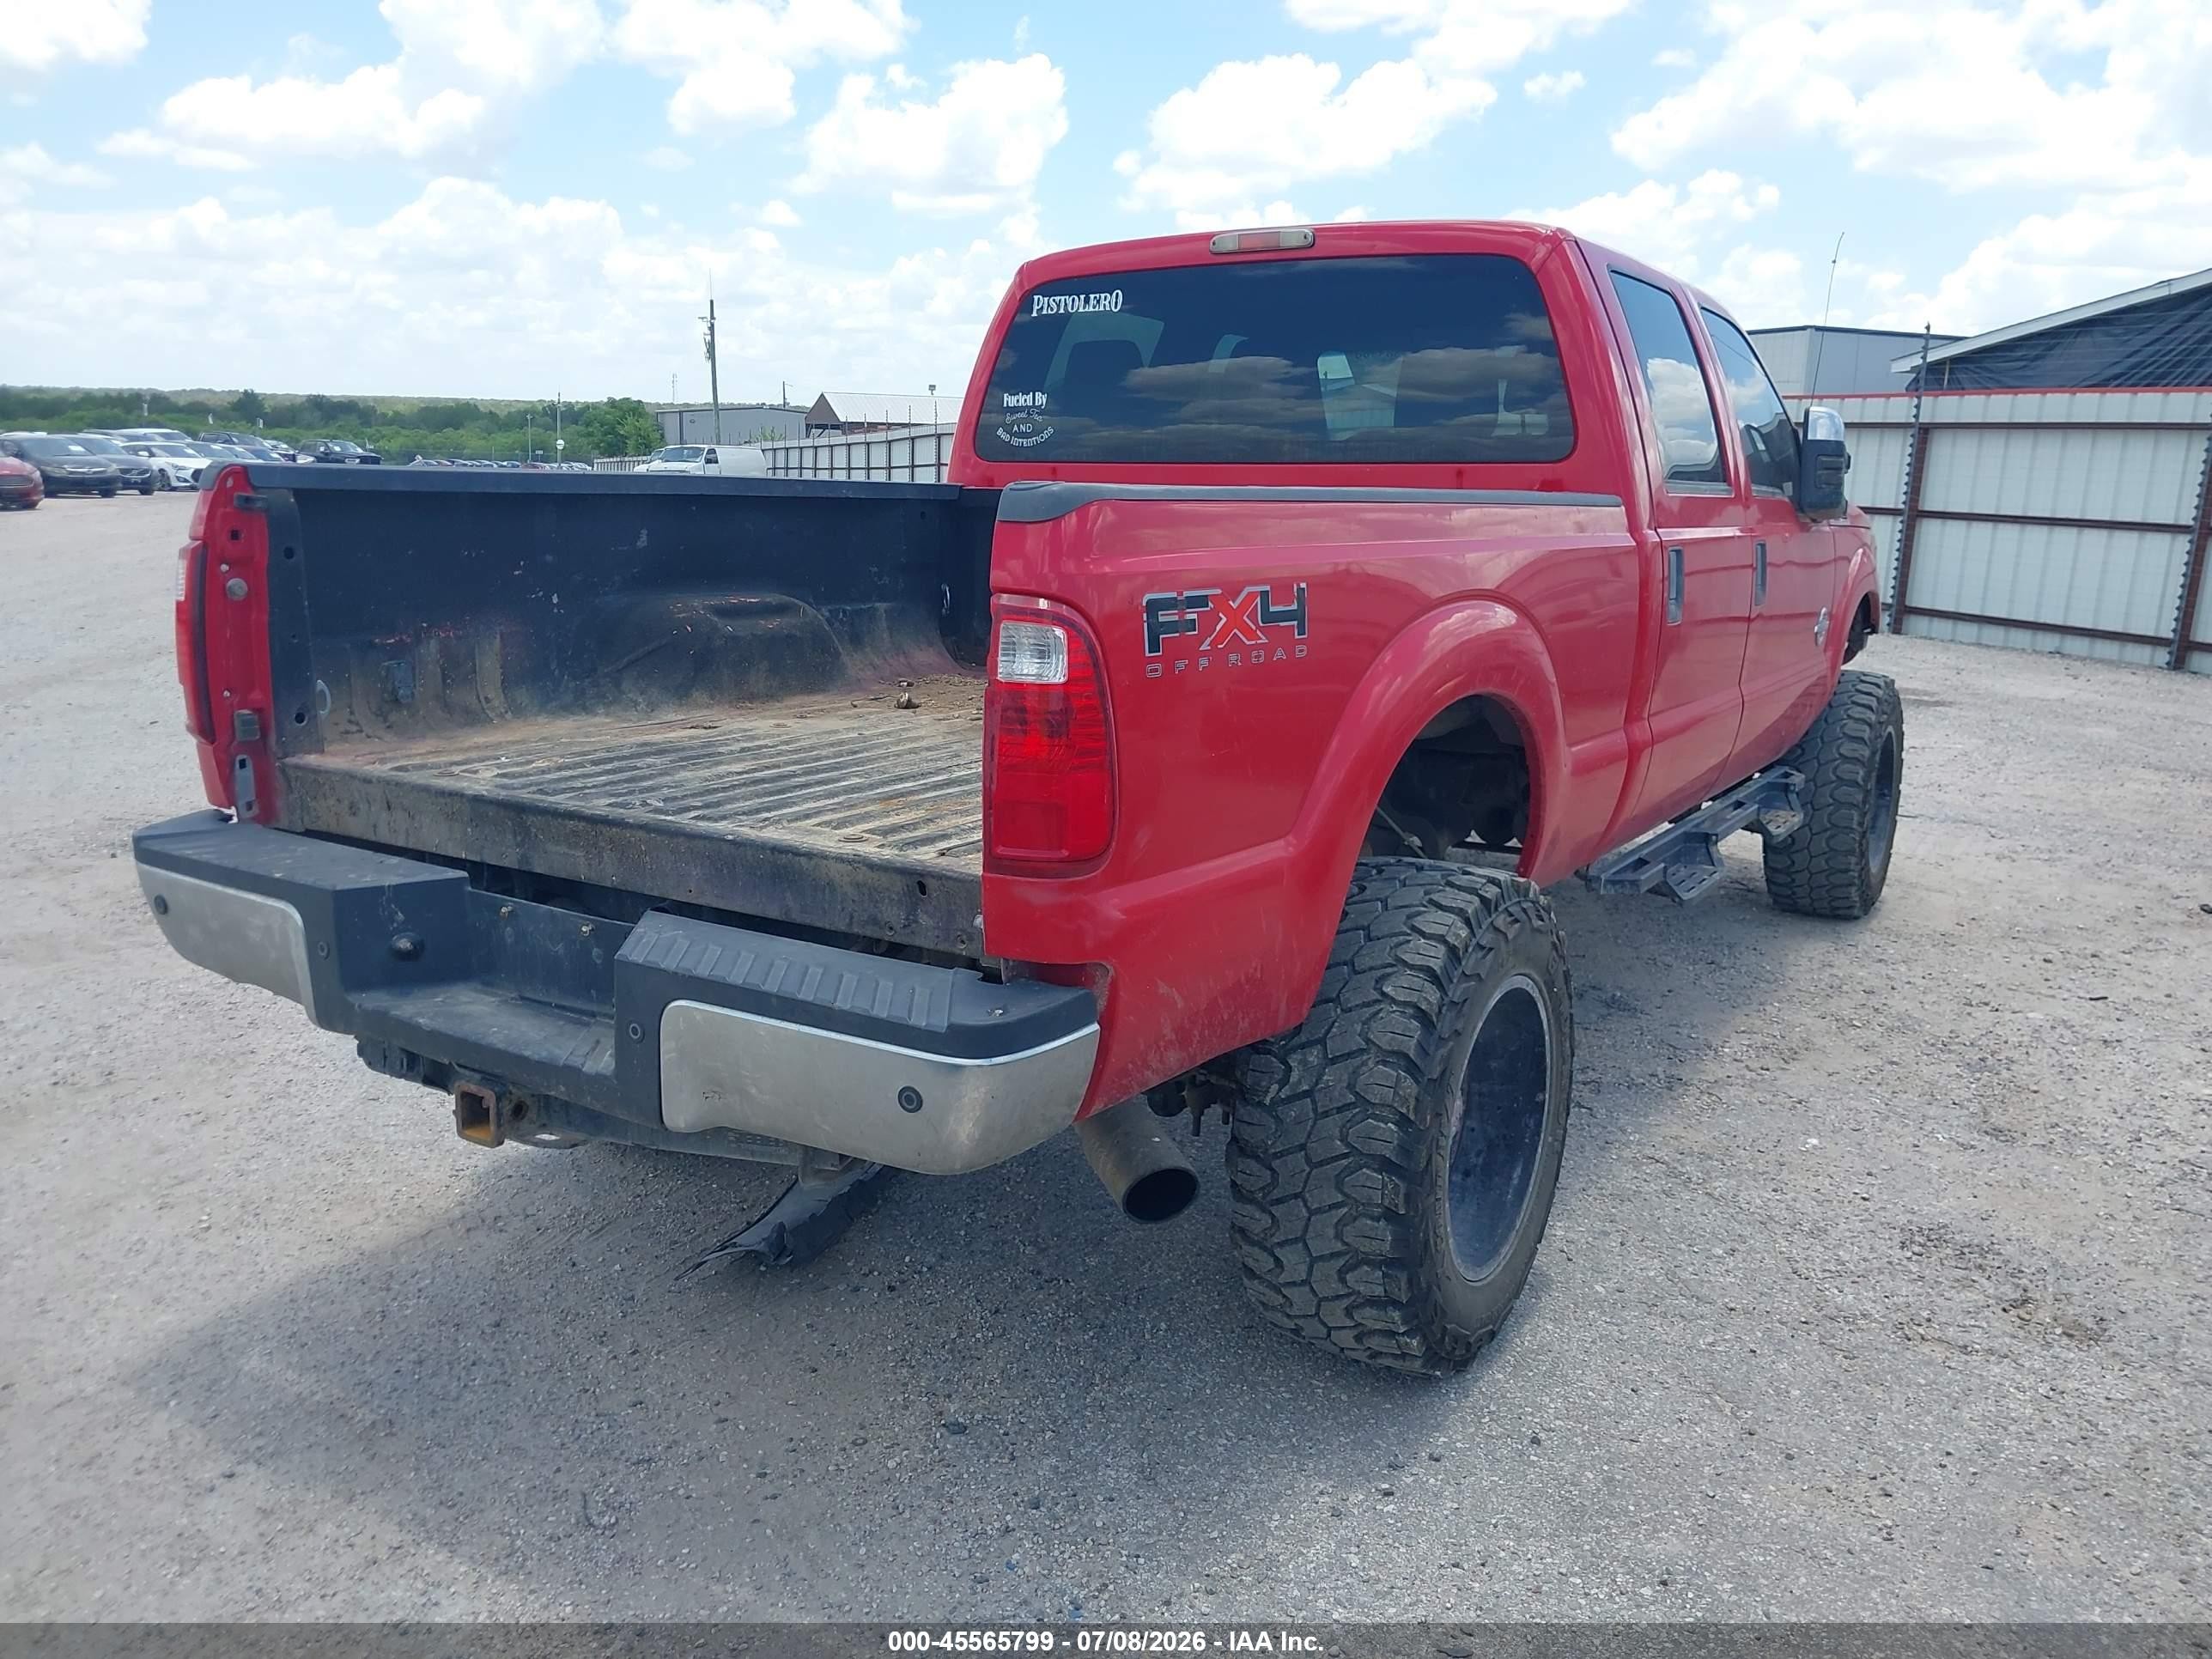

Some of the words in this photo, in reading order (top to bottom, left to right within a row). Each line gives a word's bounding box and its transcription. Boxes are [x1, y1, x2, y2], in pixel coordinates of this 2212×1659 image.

[1030, 289, 1122, 317] PISTOLERO
[1003, 392, 1033, 407] Fueled
[1035, 391, 1048, 409] By
[1005, 409, 1029, 424] Sweet
[1030, 408, 1043, 422] Tea
[996, 427, 1010, 442] BAD
[1012, 423, 1033, 434] AND
[1143, 582, 1308, 657] FX4
[1146, 657, 1212, 678] OFF
[1228, 645, 1308, 667] ROAD
